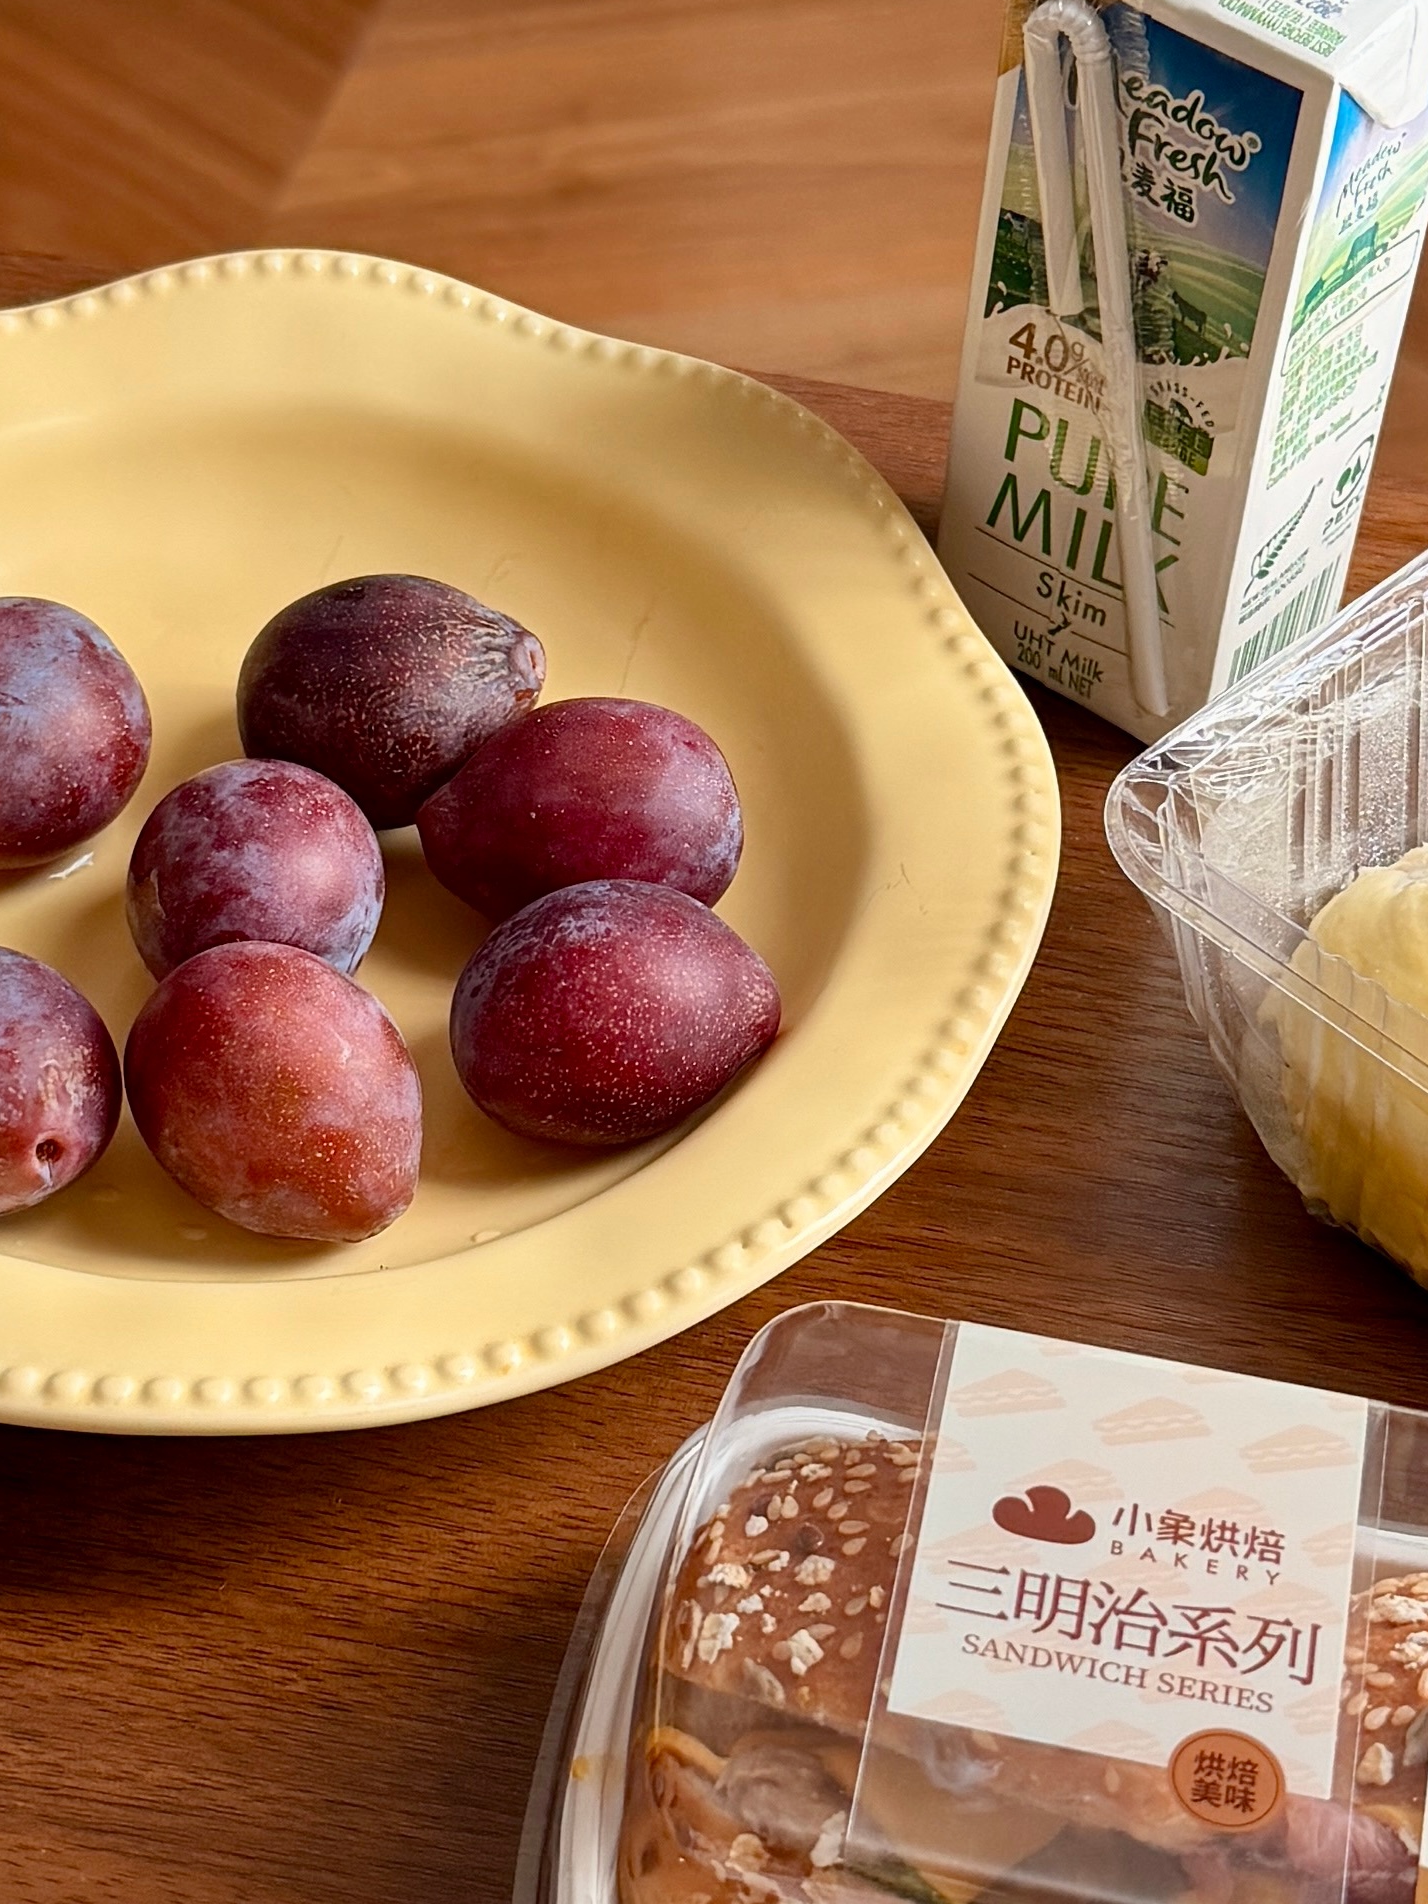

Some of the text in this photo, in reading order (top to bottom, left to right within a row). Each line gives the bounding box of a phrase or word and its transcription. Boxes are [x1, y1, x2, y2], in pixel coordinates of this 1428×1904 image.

[1110, 56, 1247, 166] eadow
[1128, 107, 1233, 201] Fresh
[1121, 150, 1195, 224] 麦福
[1006, 355, 1101, 410] PROTEIN
[1004, 398, 1189, 546] PUE
[1036, 571, 1108, 627] Skim
[1014, 620, 1104, 683] UHT Milk
[1017, 642, 1041, 669] 200
[1069, 670, 1094, 699] NET
[1110, 1540, 1281, 1586] BAKERY
[1112, 1503, 1286, 1566] 小象烘焙
[934, 1558, 1323, 1686] 三明治系列
[962, 1633, 1275, 1713] SANDWICH SERIES
[1191, 1777, 1257, 1813] 美味
[1193, 1750, 1259, 1787] 烘焙
